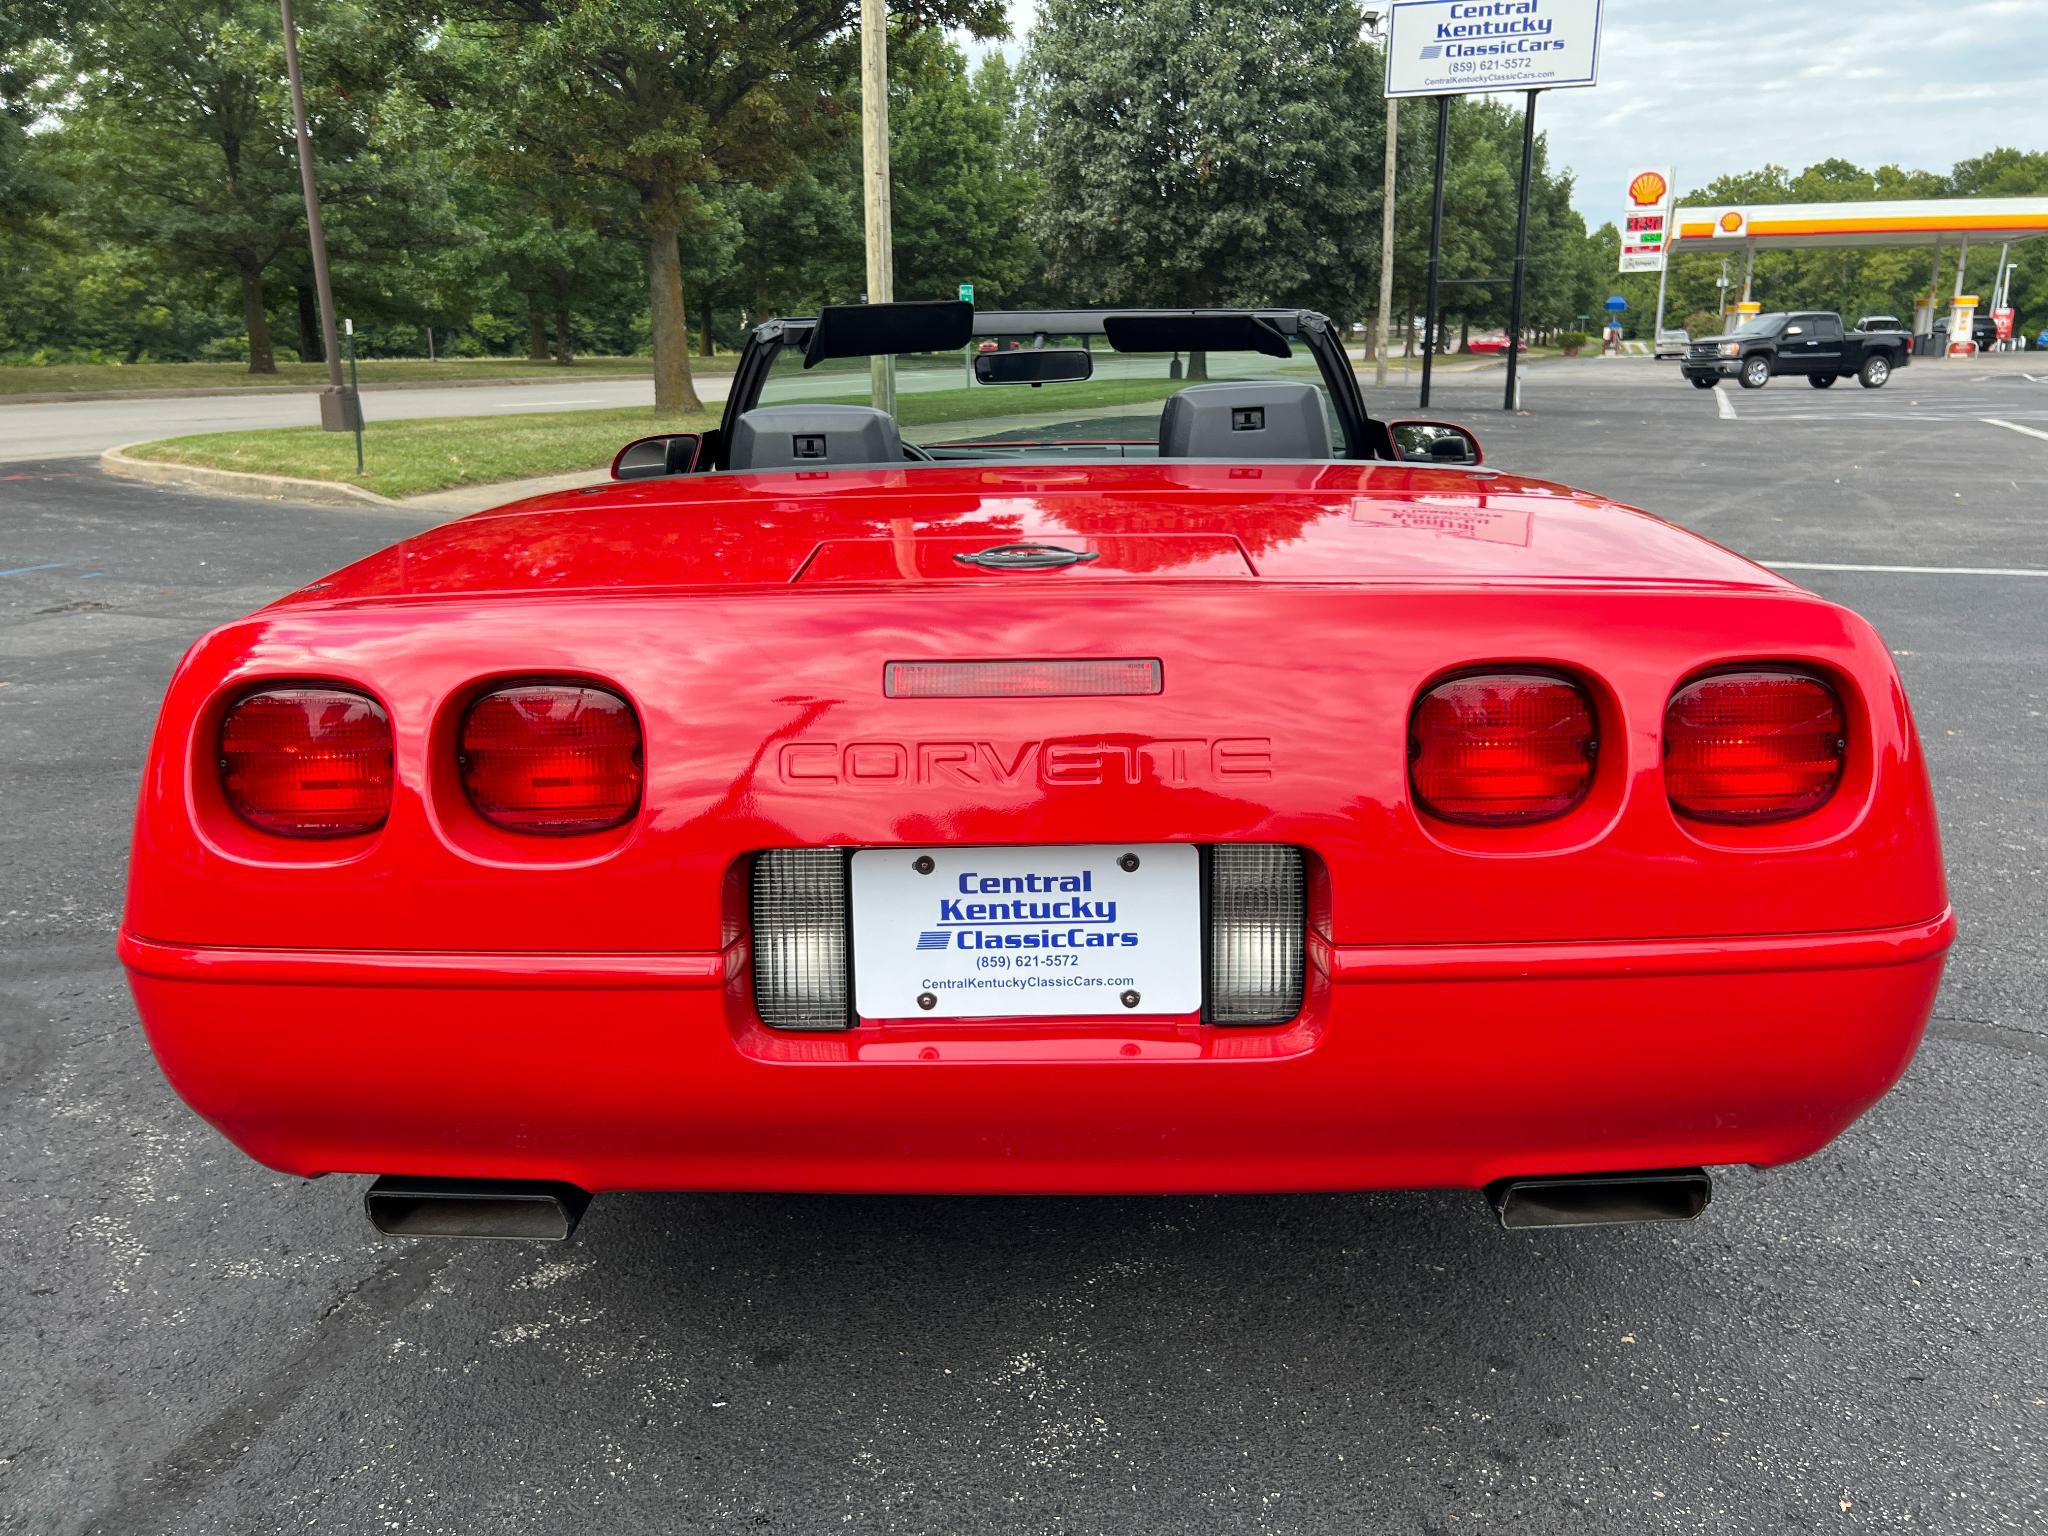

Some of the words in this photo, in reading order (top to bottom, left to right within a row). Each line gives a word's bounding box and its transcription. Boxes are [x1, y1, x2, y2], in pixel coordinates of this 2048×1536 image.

[1450, 0, 1537, 19] Central
[1437, 17, 1552, 38] Kentucky
[1444, 39, 1565, 58] ClassicCars
[1449, 61, 1476, 75] (859)
[1480, 57, 1531, 71] 621-5572
[1424, 70, 1554, 86] CentralKentuckyClassicCars.com
[779, 737, 1272, 786] CORVETTE
[958, 871, 1092, 894] Central
[940, 897, 1117, 922] Kentucky
[957, 929, 1138, 950] ClassicCars
[976, 955, 1011, 970] (859)
[1015, 954, 1079, 968] 621-5572
[922, 976, 1134, 990] CentralKentuckyClassicCars.com
